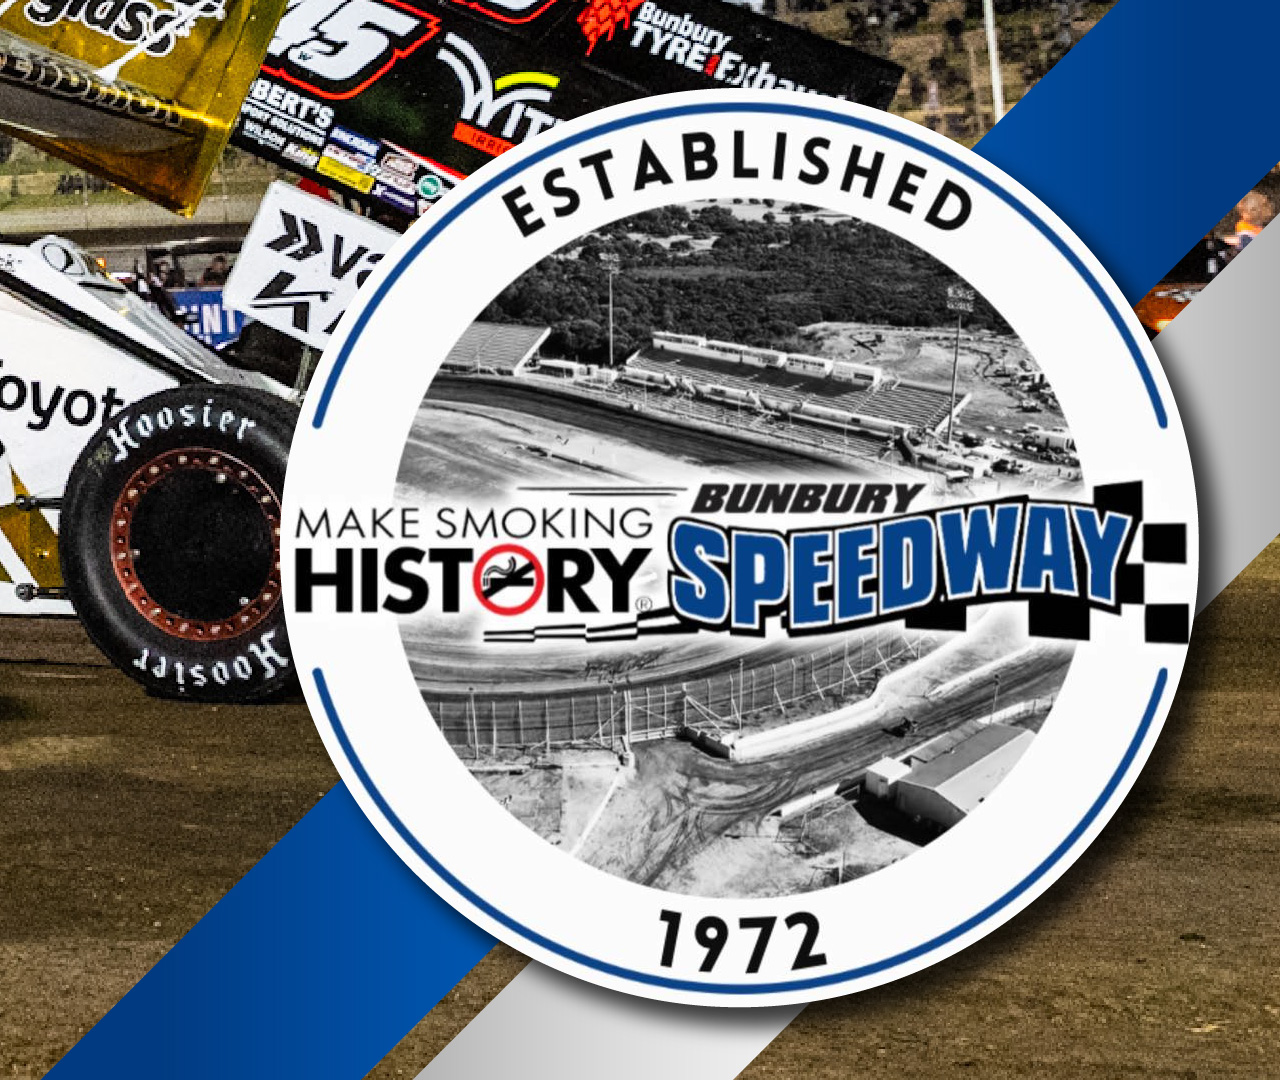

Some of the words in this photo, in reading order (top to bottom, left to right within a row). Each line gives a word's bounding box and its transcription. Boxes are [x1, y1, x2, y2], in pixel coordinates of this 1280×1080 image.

[630, 20, 706, 73] TYRE
[639, 0, 733, 53] Bunbury
[248, 76, 336, 129] BERT'S
[106, 398, 258, 463] Hoosier
[133, 628, 290, 693] Hoosier
